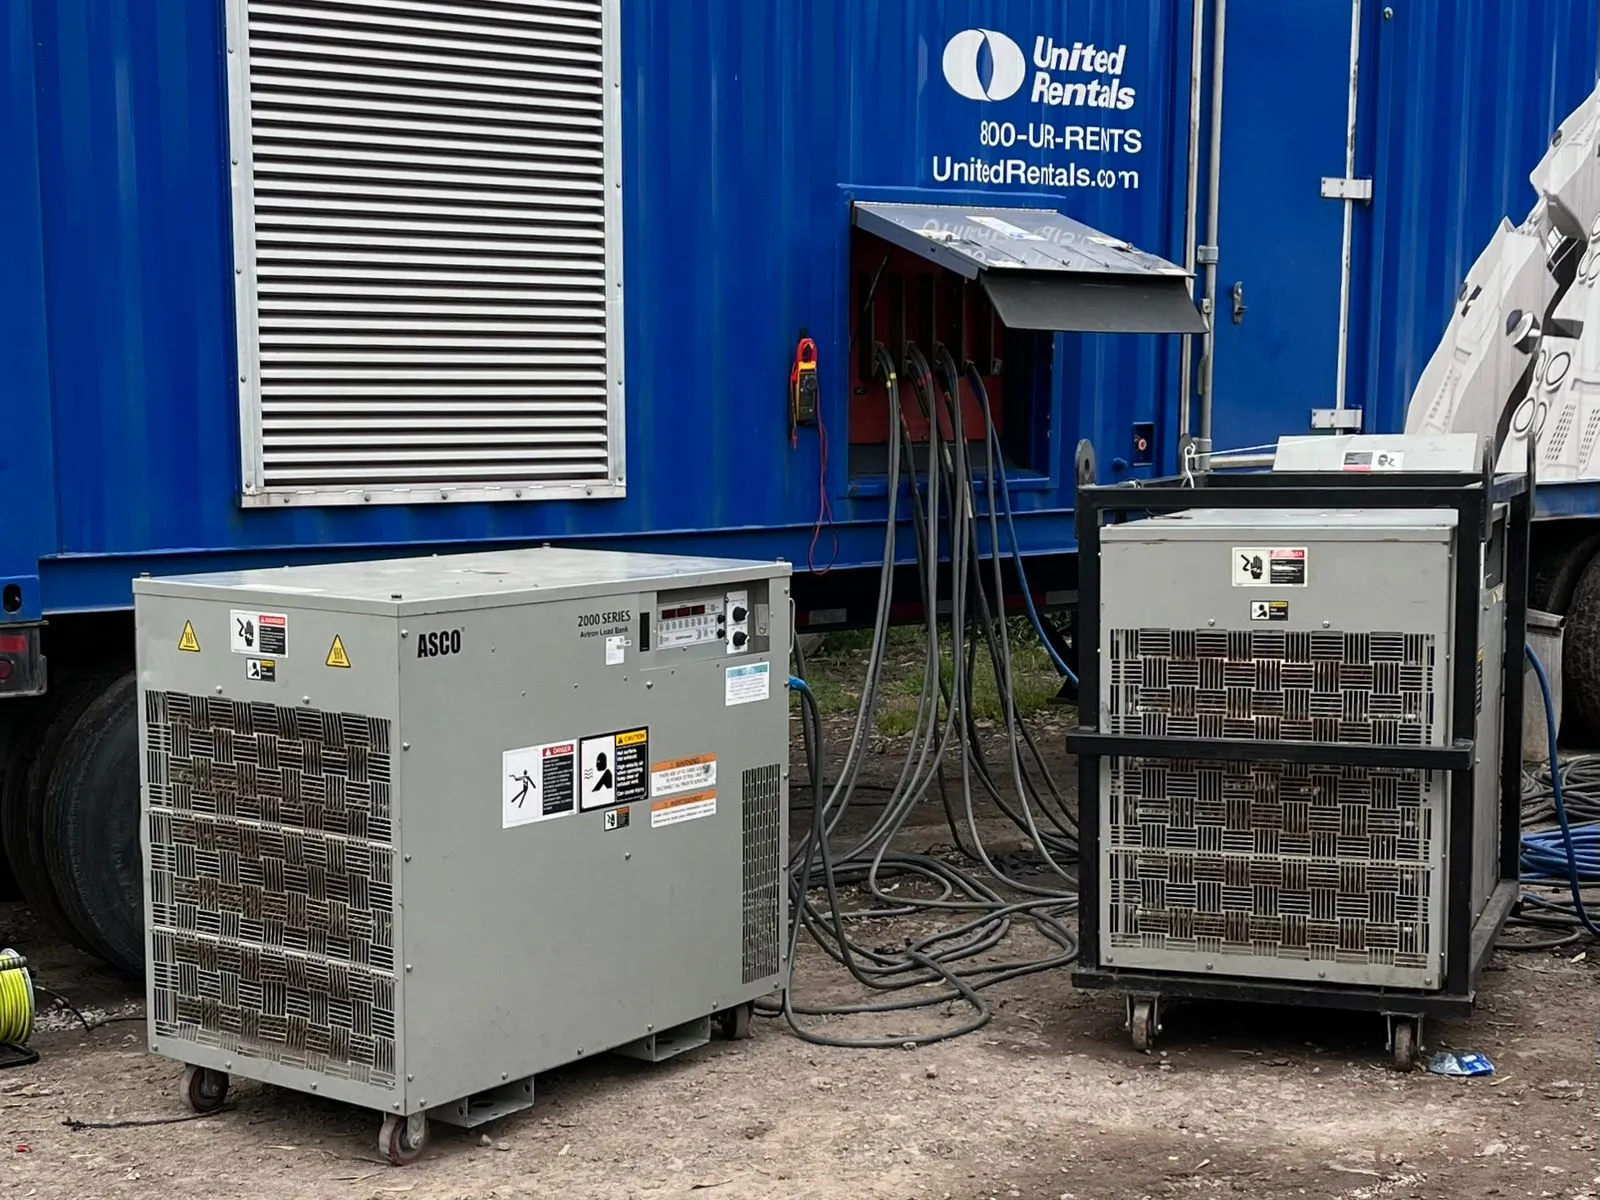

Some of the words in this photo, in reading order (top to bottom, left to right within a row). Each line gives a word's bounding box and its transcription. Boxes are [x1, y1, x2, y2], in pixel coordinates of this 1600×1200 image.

[1033, 36, 1127, 75] United
[1031, 71, 1136, 110] Rentals
[980, 120, 1143, 154] 800-UR-RENTS
[932, 155, 1139, 189] UnitedRentals.com
[578, 613, 600, 627] 2000
[602, 610, 631, 624] SERIES
[600, 628, 613, 636] Load
[615, 626, 628, 634] Bank
[417, 629, 461, 658] ASCO
[624, 732, 645, 743] CAUTION
